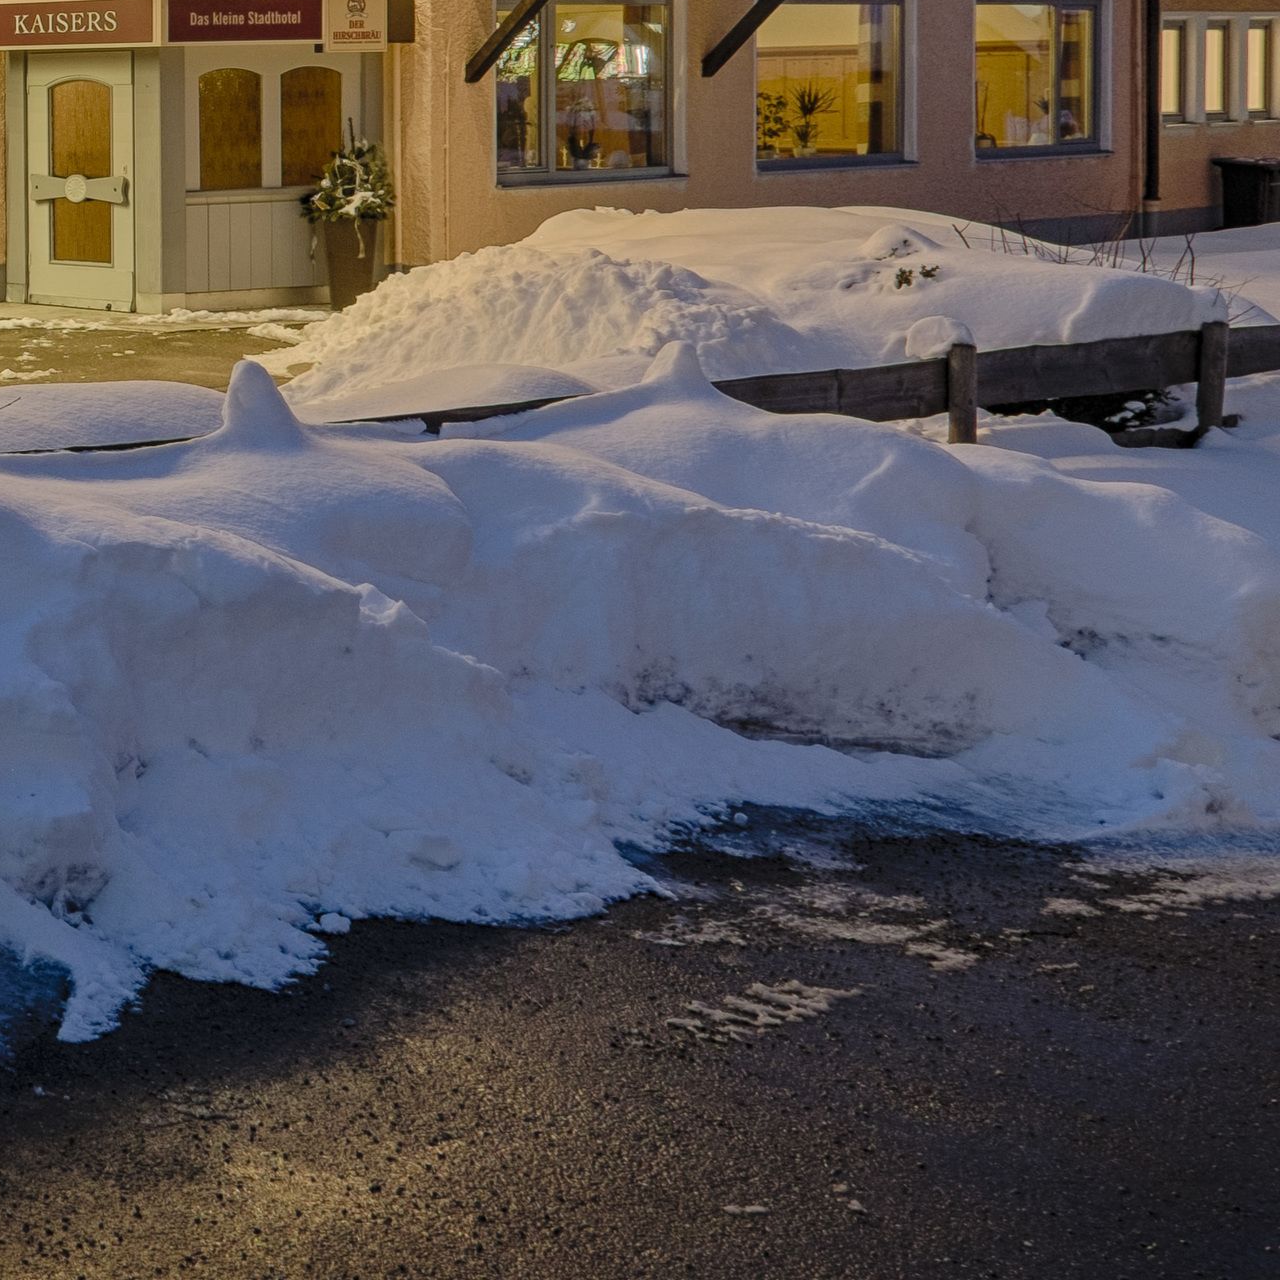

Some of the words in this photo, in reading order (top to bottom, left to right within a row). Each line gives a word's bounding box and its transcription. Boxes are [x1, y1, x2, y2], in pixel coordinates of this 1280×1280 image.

[14, 11, 117, 35] KAISERS
[190, 12, 209, 26] Das
[212, 12, 245, 25] kleine
[247, 10, 301, 25] Stadthotel
[349, 20, 364, 29] DER
